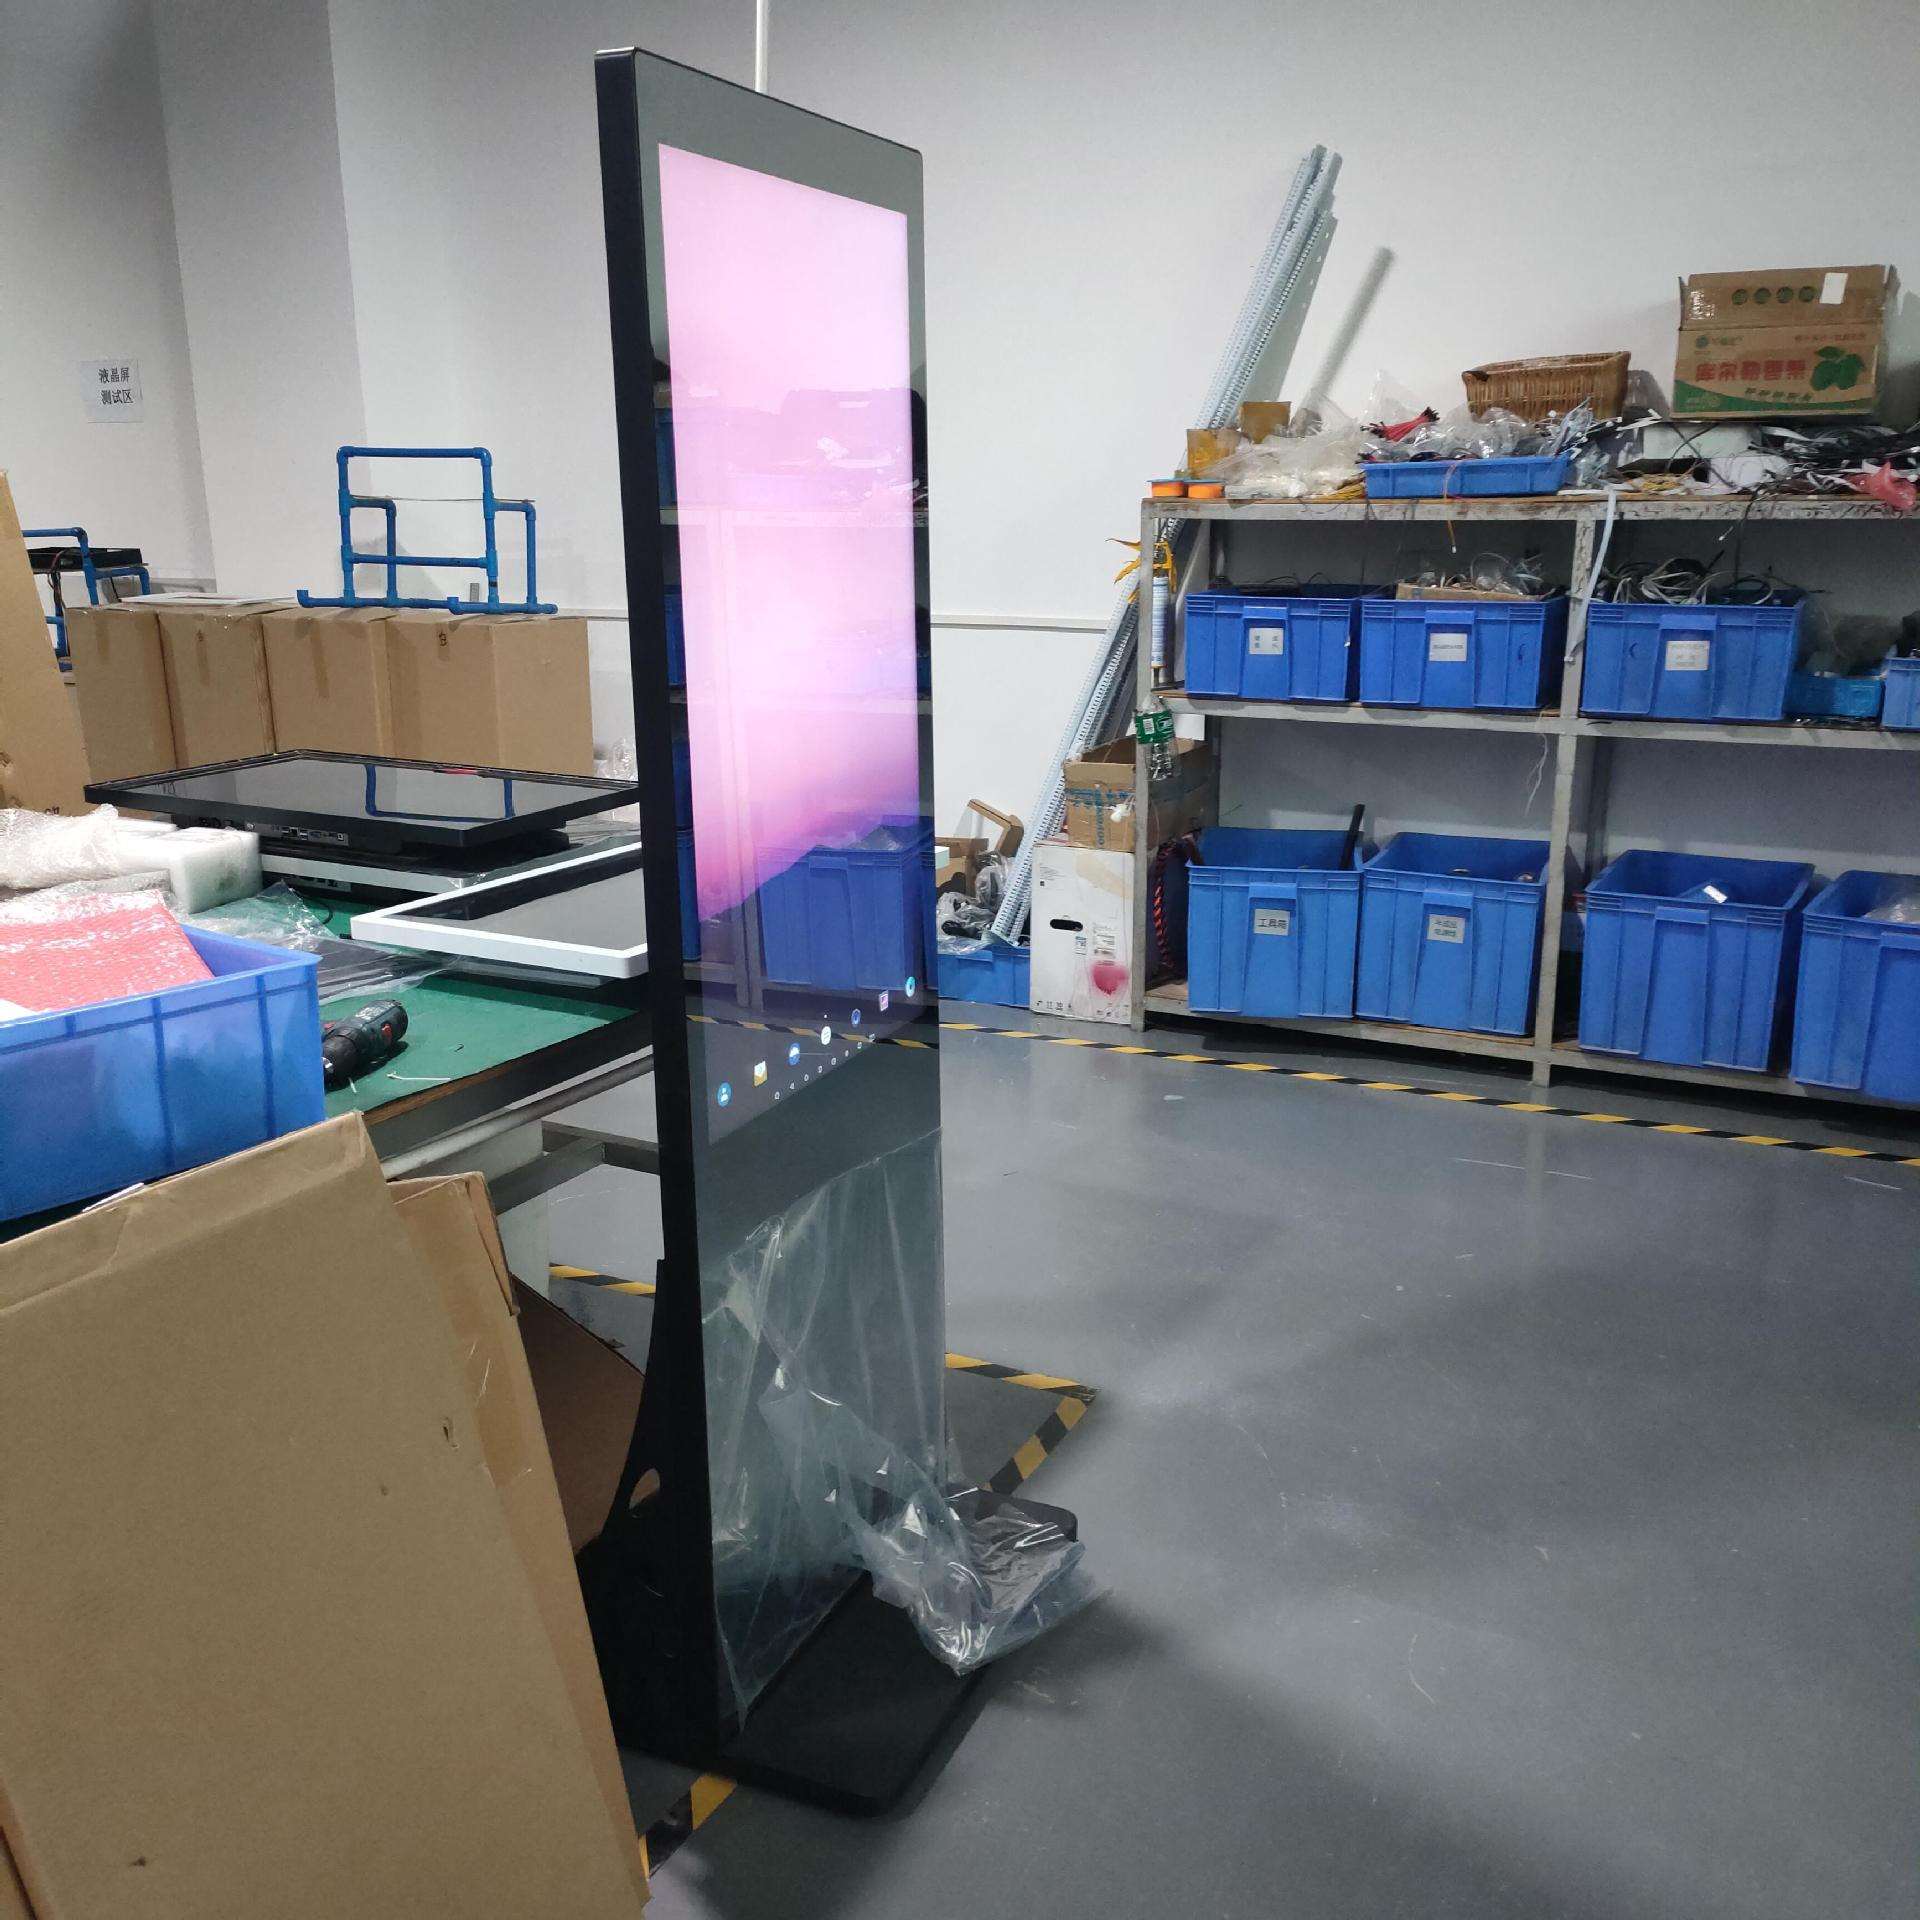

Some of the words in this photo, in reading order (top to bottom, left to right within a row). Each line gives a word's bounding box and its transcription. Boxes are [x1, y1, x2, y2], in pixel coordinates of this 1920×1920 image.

[99, 367, 129, 384] 液晶屏
[101, 389, 133, 404] 测试区
